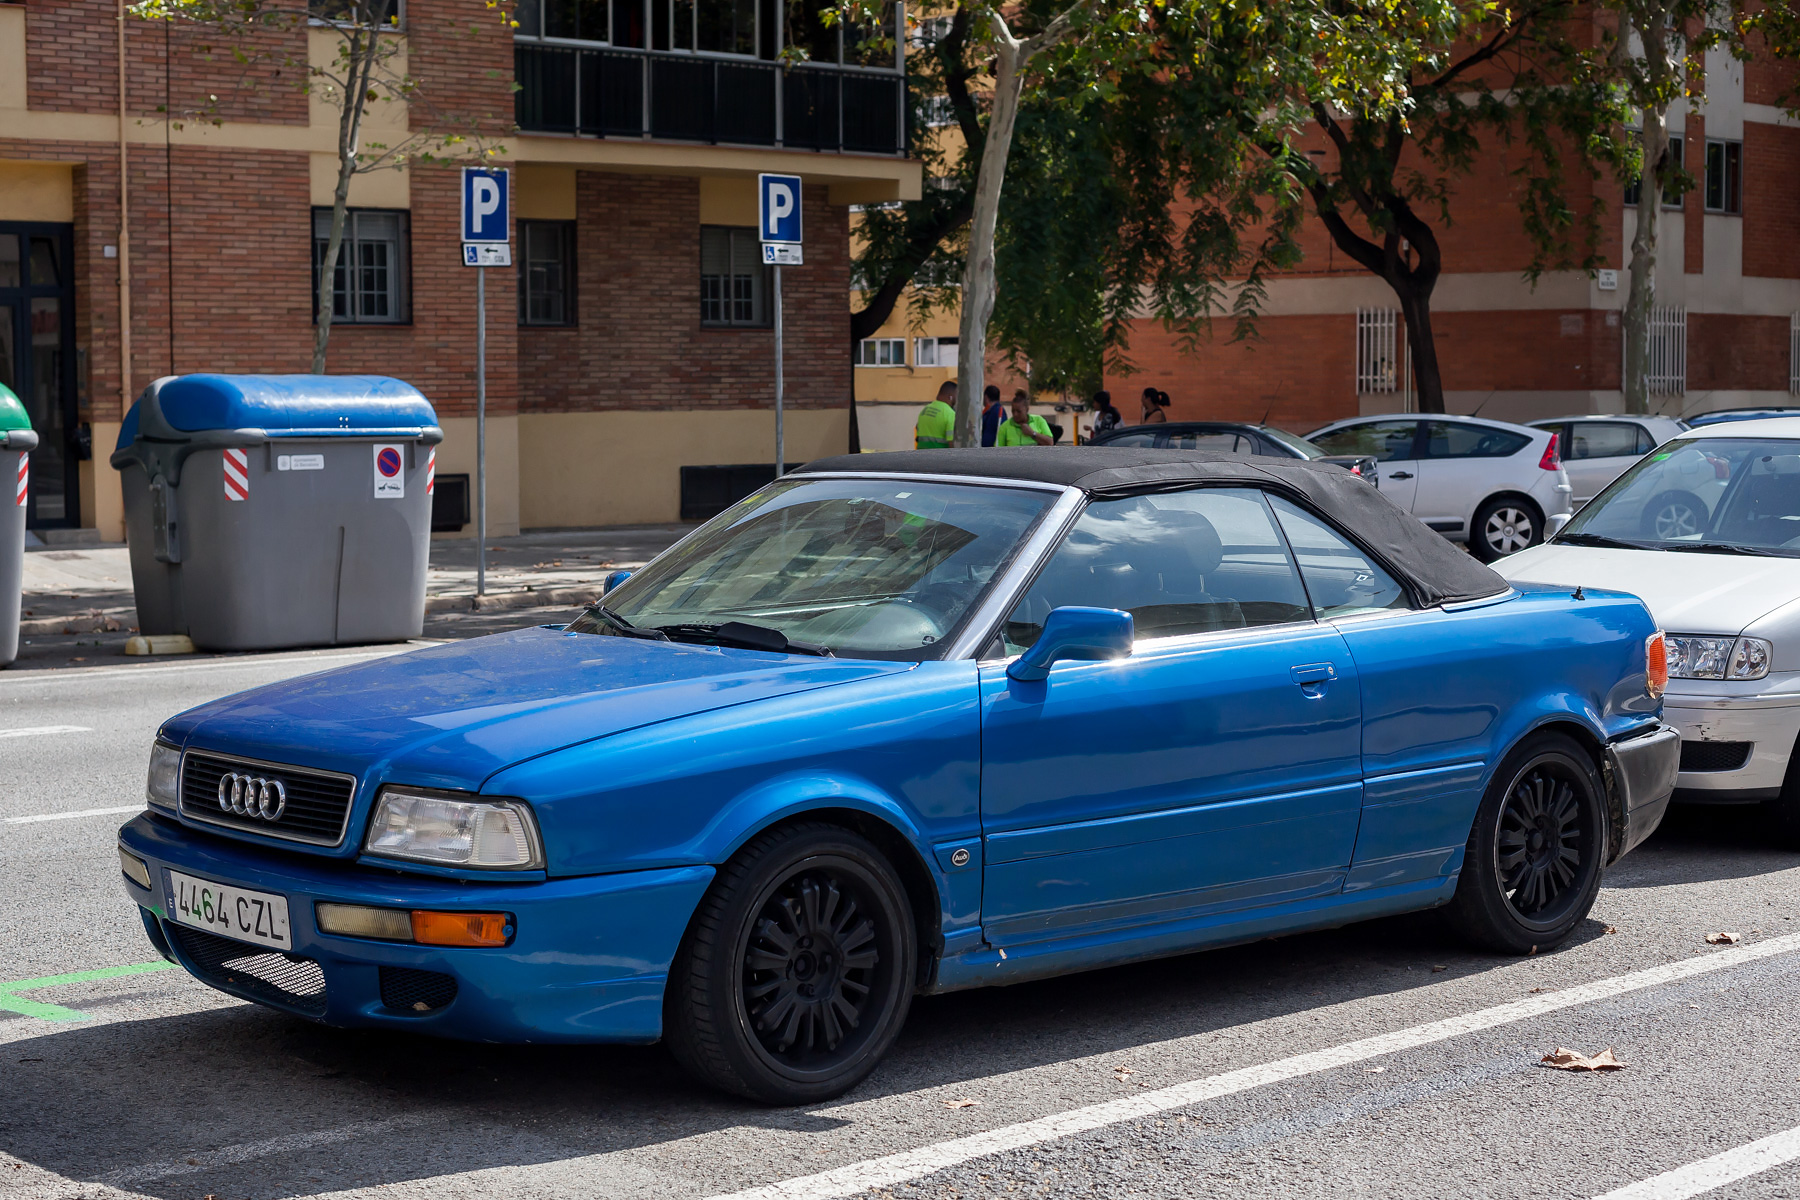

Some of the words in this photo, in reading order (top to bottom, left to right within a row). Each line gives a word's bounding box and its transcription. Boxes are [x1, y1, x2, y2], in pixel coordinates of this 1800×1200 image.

[472, 176, 500, 233] P
[769, 183, 793, 234] P
[169, 898, 173, 908] E
[180, 881, 229, 929] 4464
[236, 896, 284, 941] CZL
